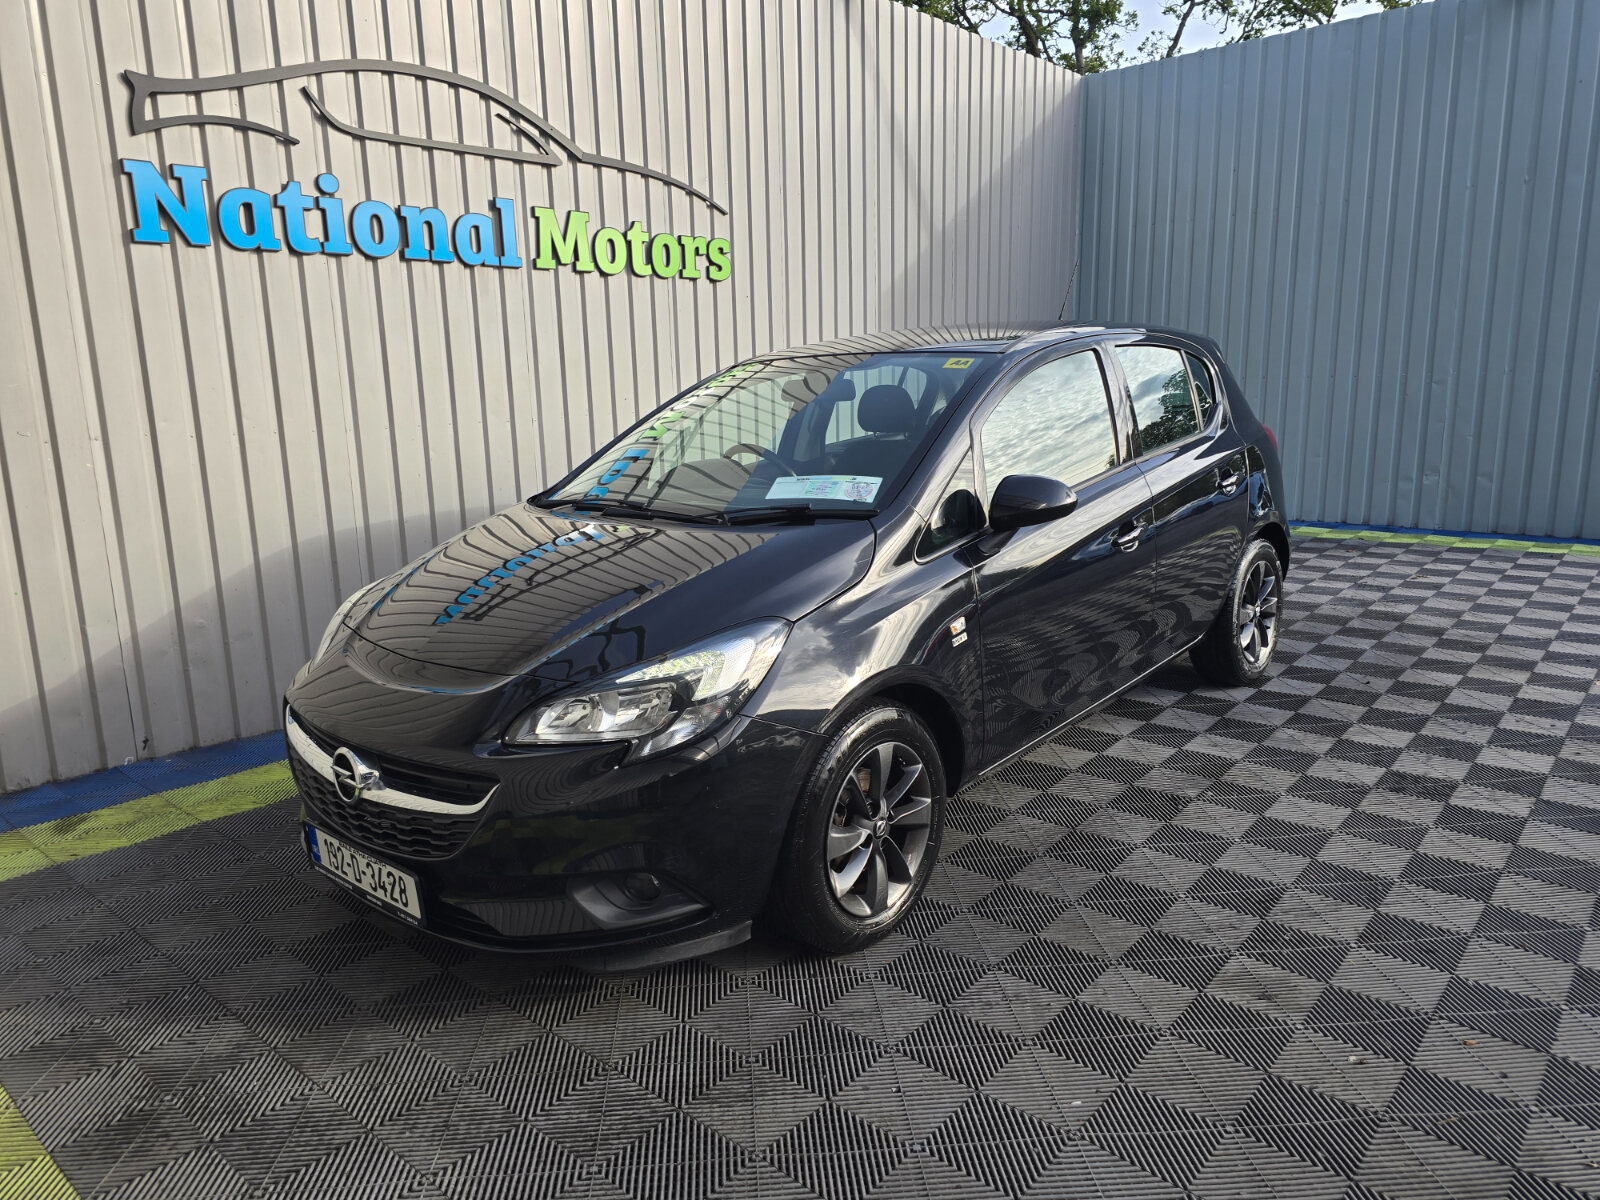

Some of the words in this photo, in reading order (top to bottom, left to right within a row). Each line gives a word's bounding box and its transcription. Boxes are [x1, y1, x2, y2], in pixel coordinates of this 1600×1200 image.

[121, 159, 522, 268] National
[533, 206, 731, 281] Motors
[324, 838, 408, 908] 192-D-3428
